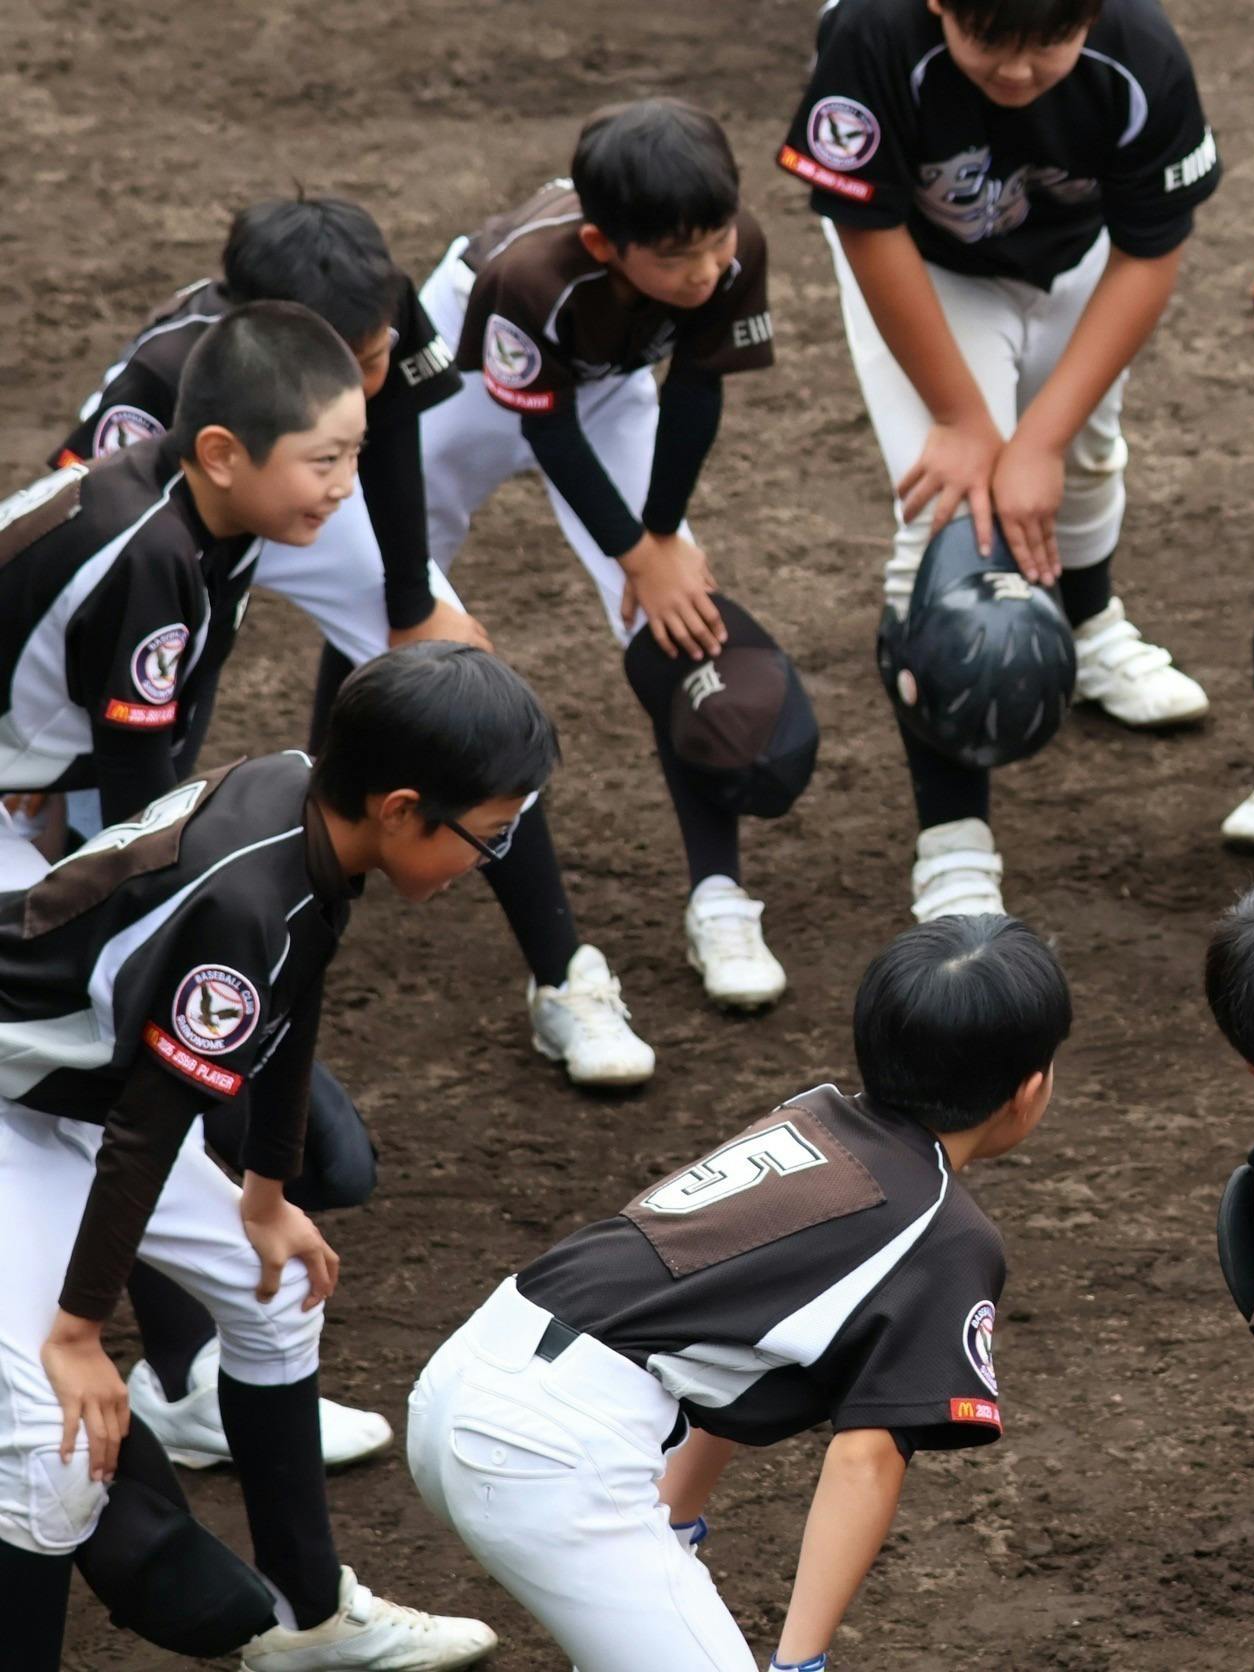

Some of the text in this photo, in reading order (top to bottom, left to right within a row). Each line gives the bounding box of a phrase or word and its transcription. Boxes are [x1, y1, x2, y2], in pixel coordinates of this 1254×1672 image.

[194, 970, 243, 989] BASEBALL
[195, 1064, 235, 1090] PLAYER
[640, 1121, 829, 1214] 5
